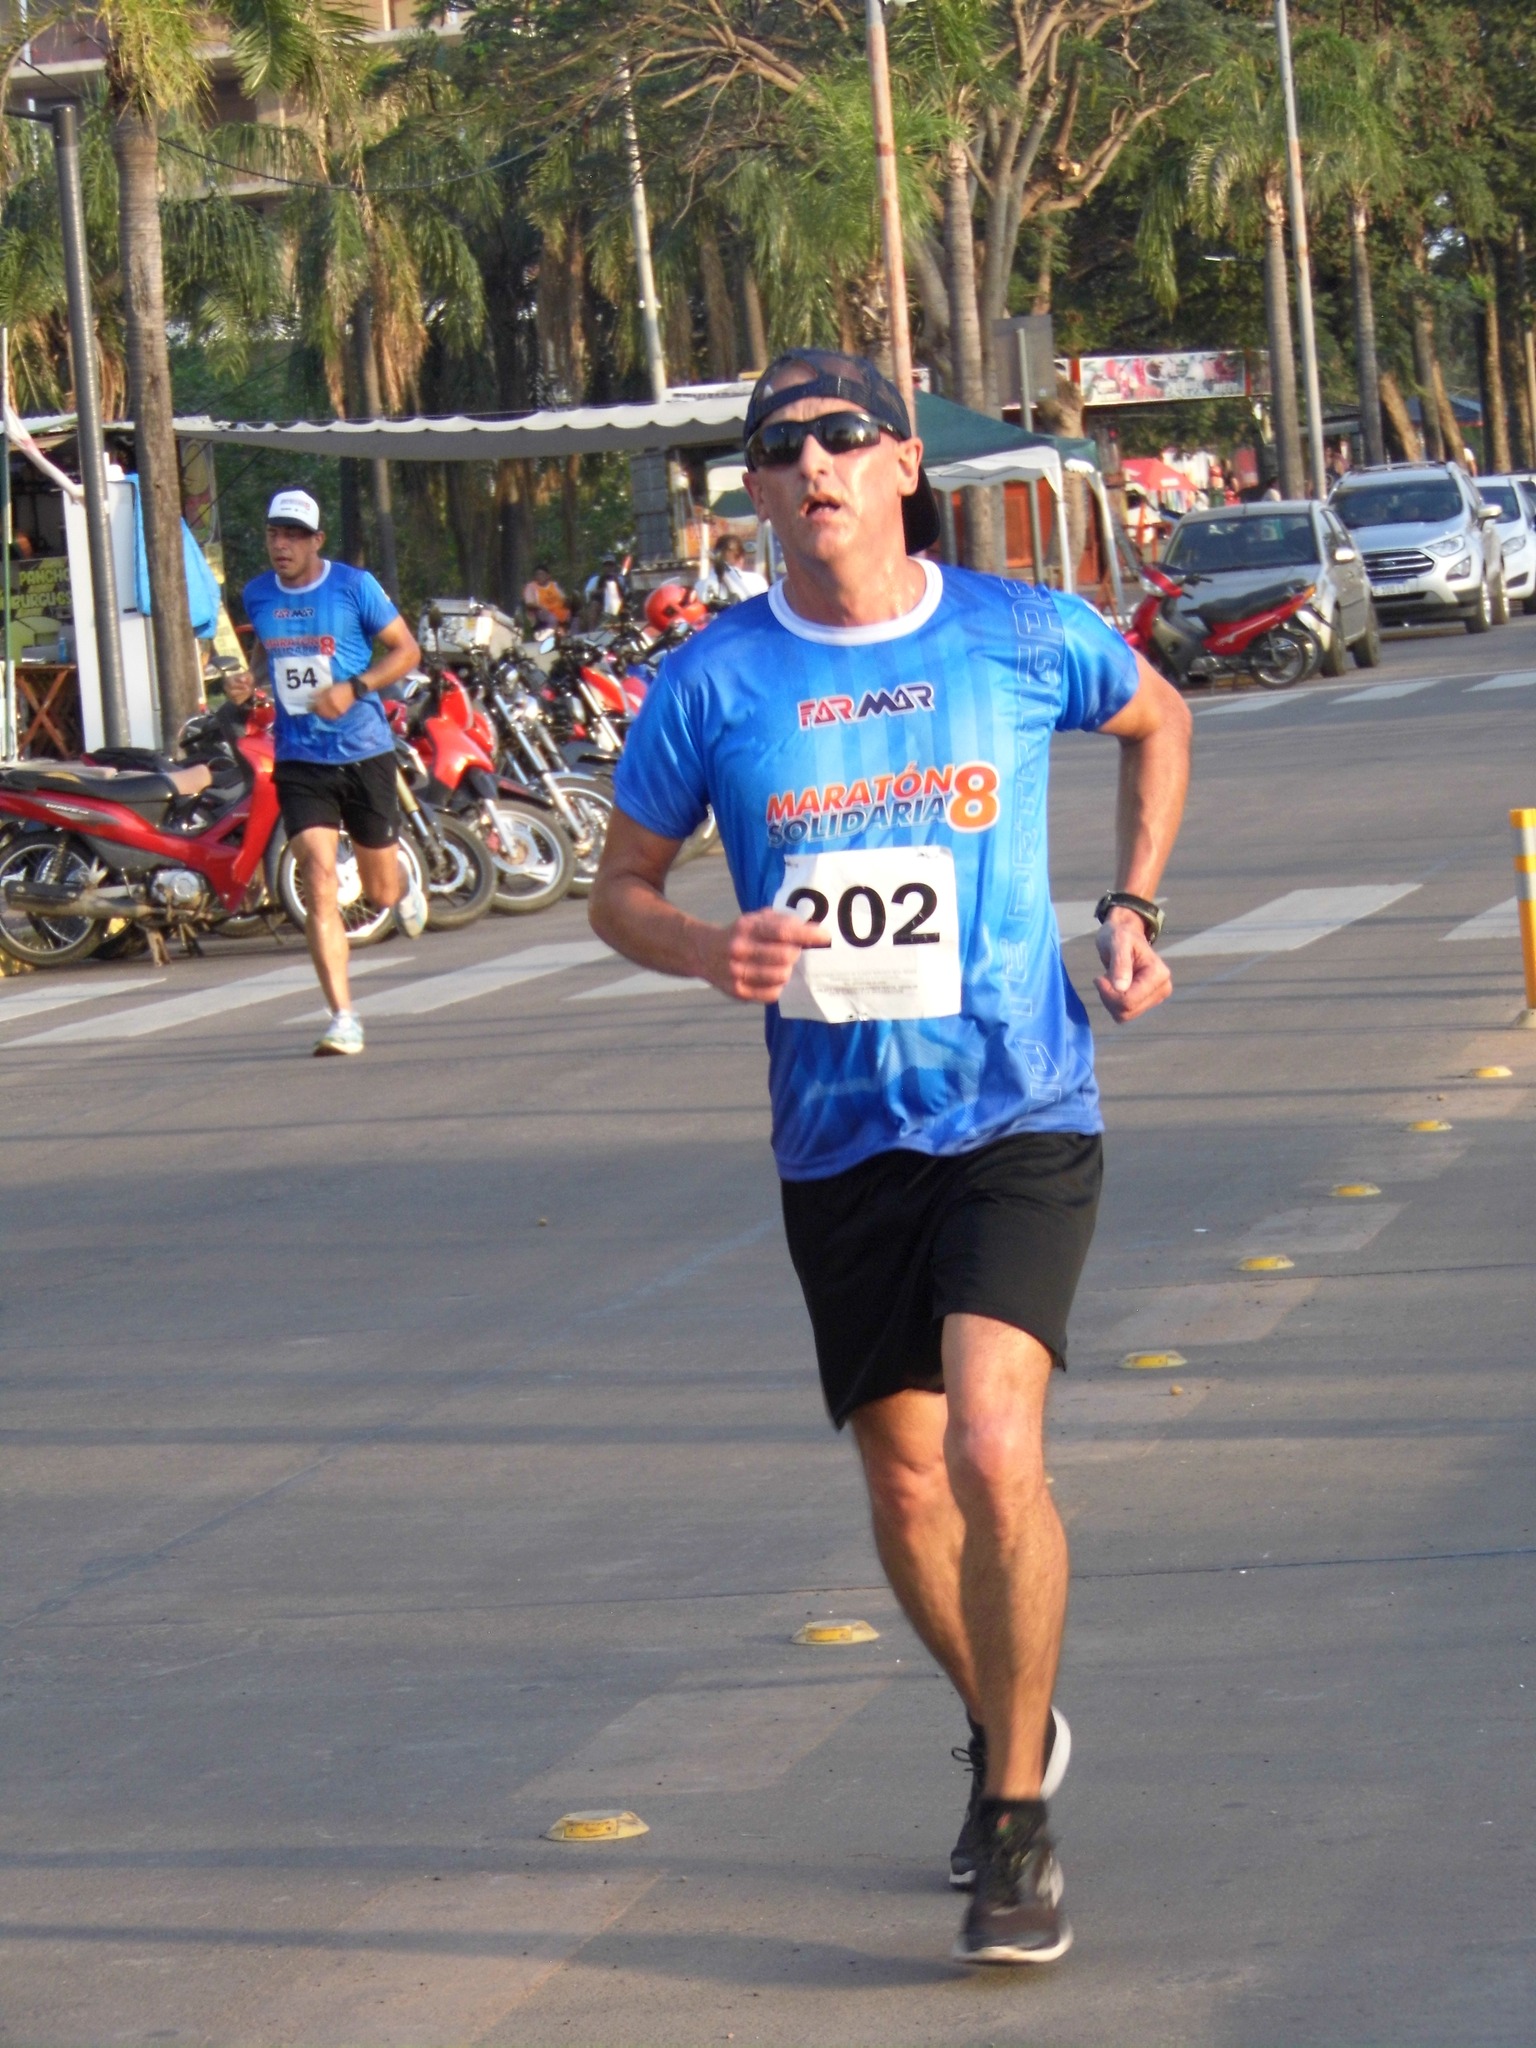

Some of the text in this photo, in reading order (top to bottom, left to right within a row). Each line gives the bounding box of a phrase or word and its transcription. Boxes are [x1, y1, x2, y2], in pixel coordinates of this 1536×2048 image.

[320, 635, 336, 656] 8
[286, 667, 319, 690] 54
[798, 682, 936, 729] FARMAR
[766, 760, 1000, 833] MARATÓN 8
[767, 796, 952, 848] SOLIDARIA
[786, 882, 941, 949] 202
